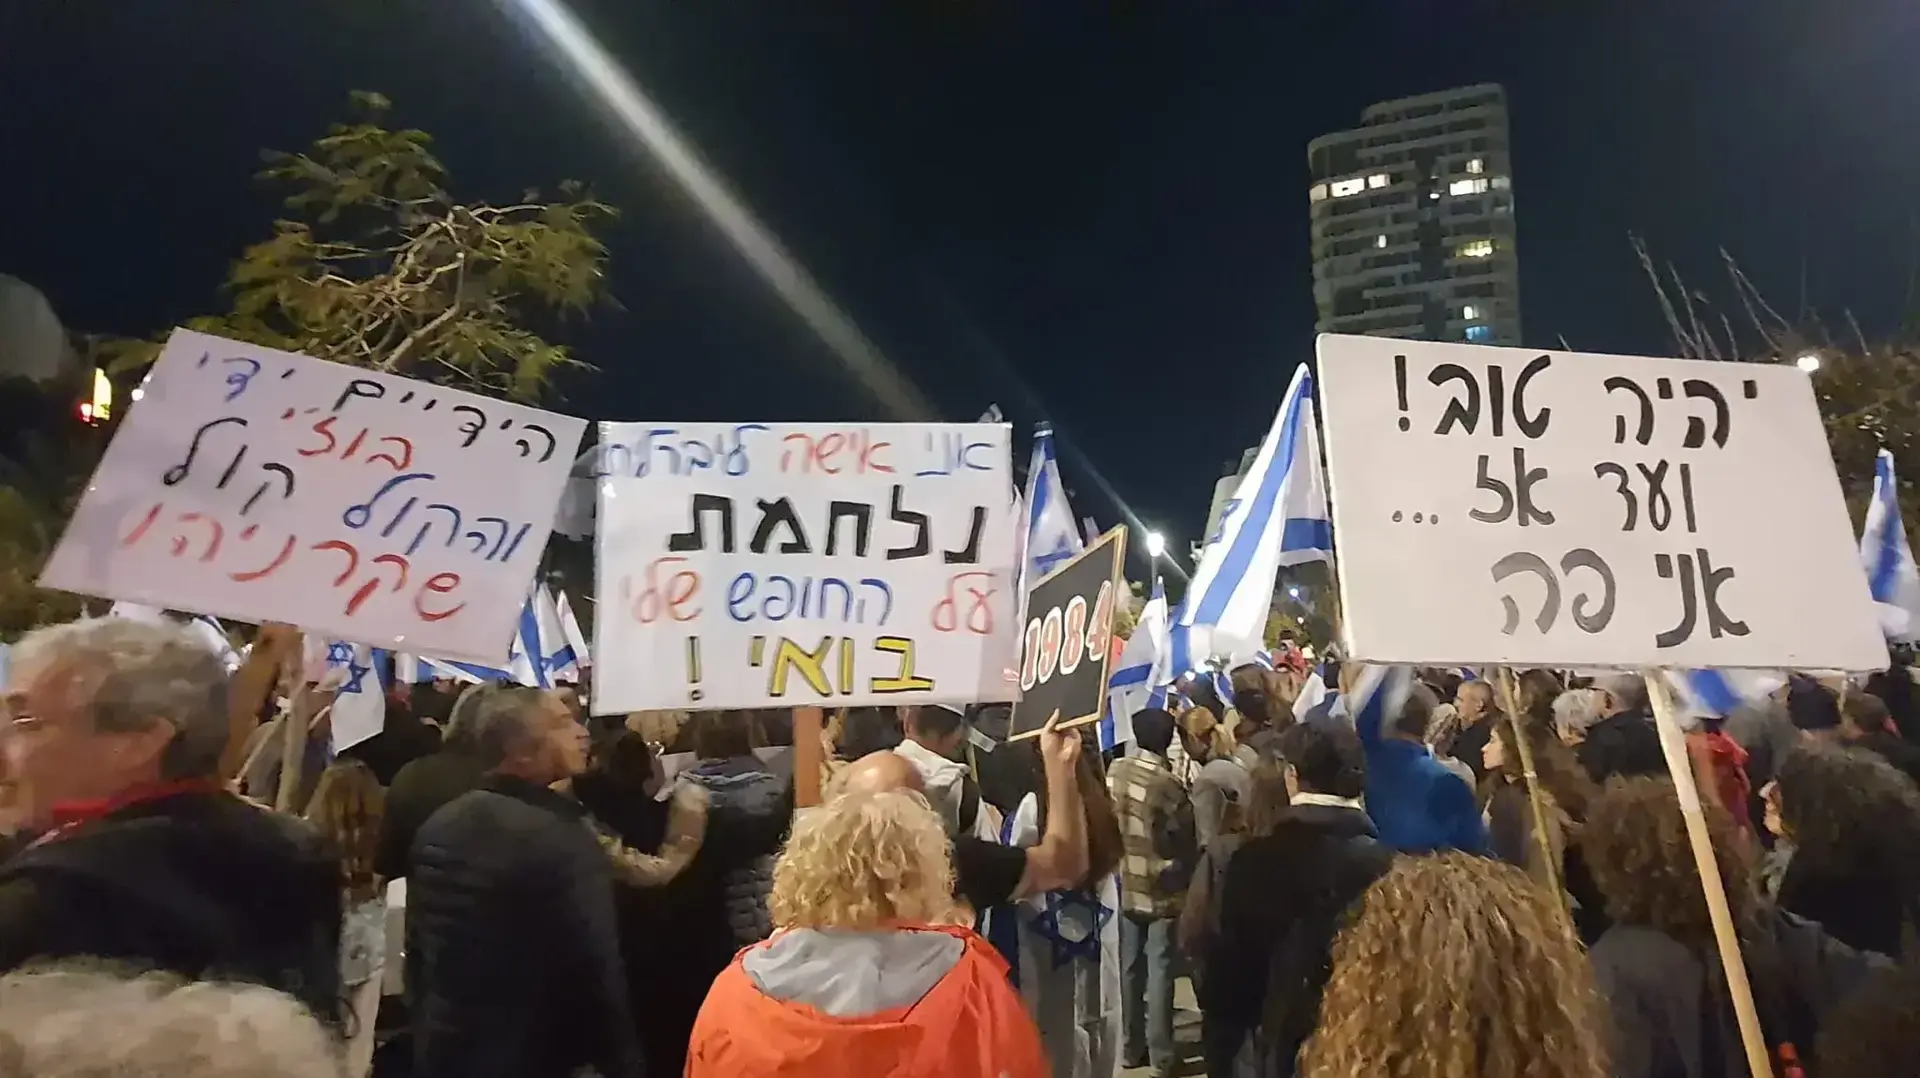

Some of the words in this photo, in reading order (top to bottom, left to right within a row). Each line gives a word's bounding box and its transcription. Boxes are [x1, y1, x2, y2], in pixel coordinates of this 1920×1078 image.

[197, 351, 296, 402] ידי
[1394, 354, 1552, 440] טוב!
[1604, 376, 1757, 449] יהיה
[332, 379, 556, 463] הידיים
[782, 429, 897, 474] אישה
[915, 432, 996, 476] אני
[163, 417, 294, 515] קול
[1594, 459, 1697, 533] ועד
[343, 474, 532, 562] והקול
[668, 484, 987, 563] נלחמת
[123, 503, 465, 622] שקרניהו
[620, 556, 702, 623] שלי
[727, 571, 894, 626] החופש
[1491, 547, 1616, 635] פה
[1655, 548, 1751, 649] אני
[932, 571, 999, 634] על
[1020, 580, 1112, 692] 1984
